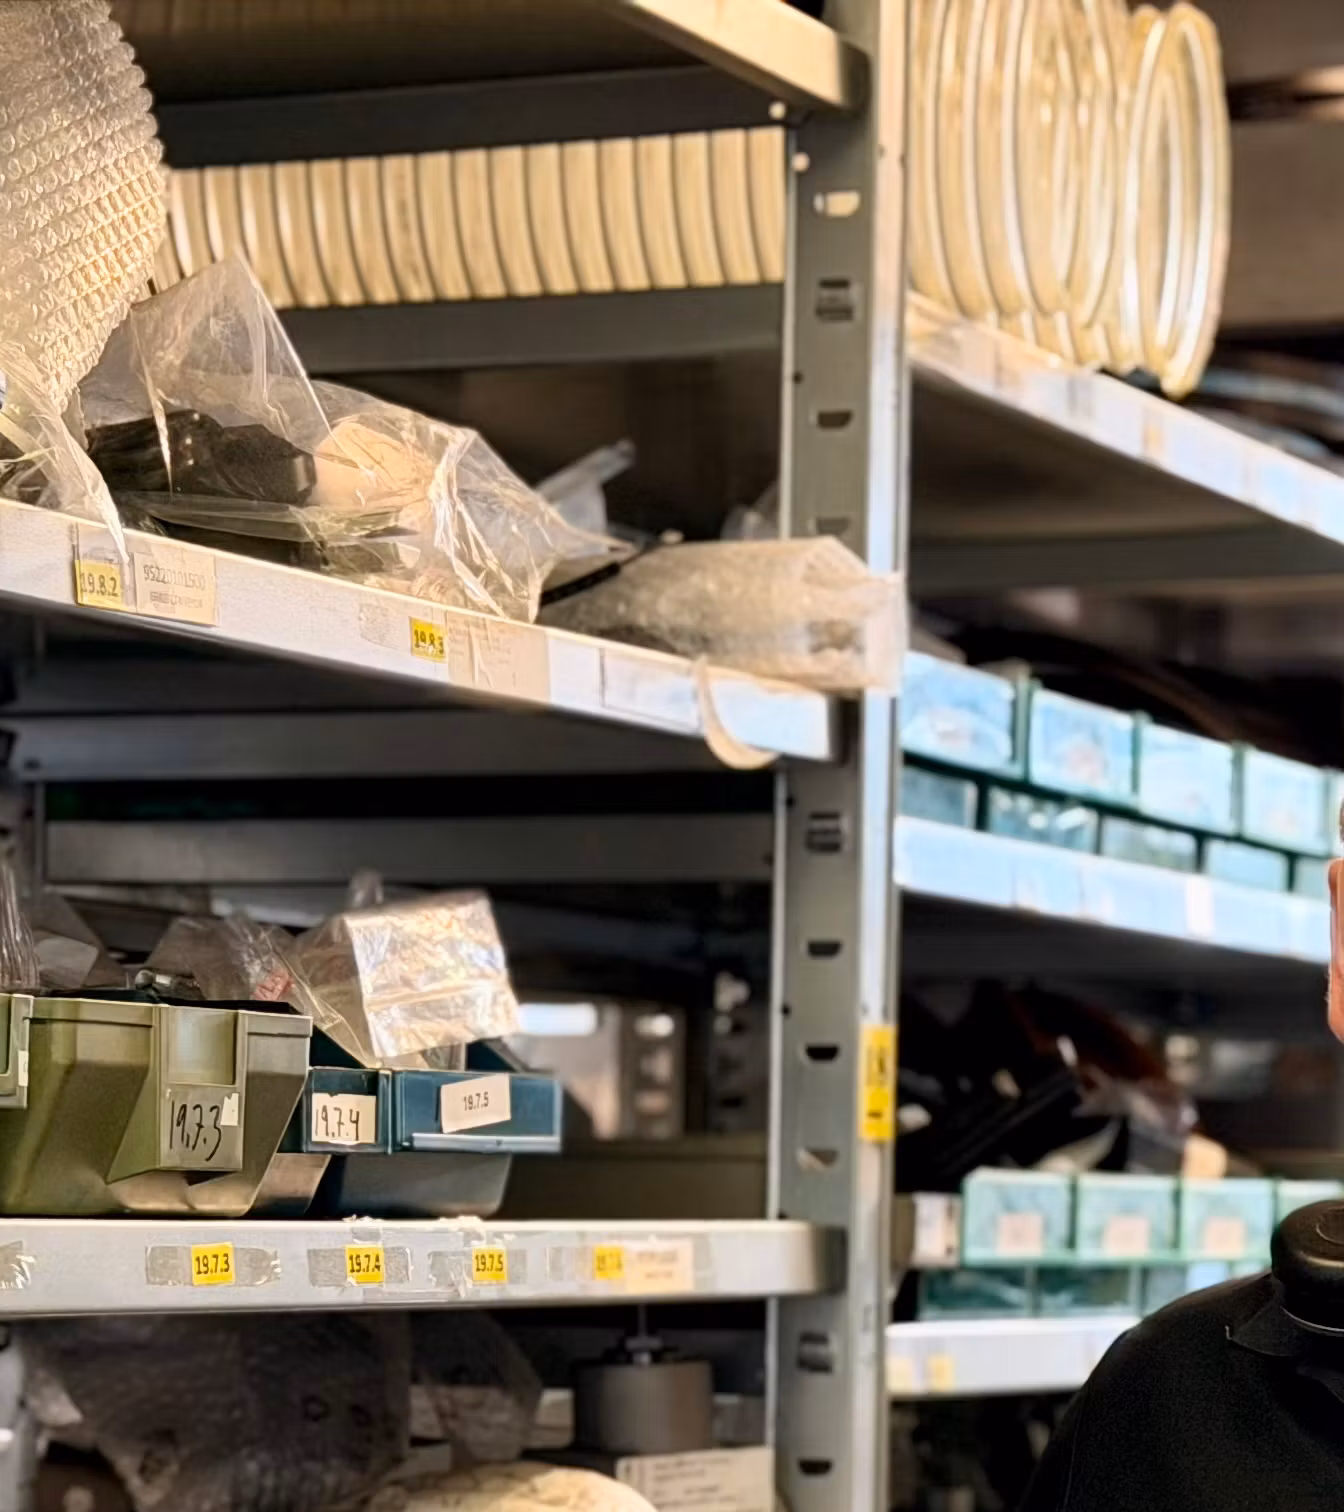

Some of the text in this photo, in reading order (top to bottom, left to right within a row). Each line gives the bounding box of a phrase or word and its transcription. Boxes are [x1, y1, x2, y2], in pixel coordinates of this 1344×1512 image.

[314, 1107, 361, 1142] 19.7.4
[195, 1252, 231, 1275] 19.7.3
[474, 1253, 504, 1273] 19.7.5
